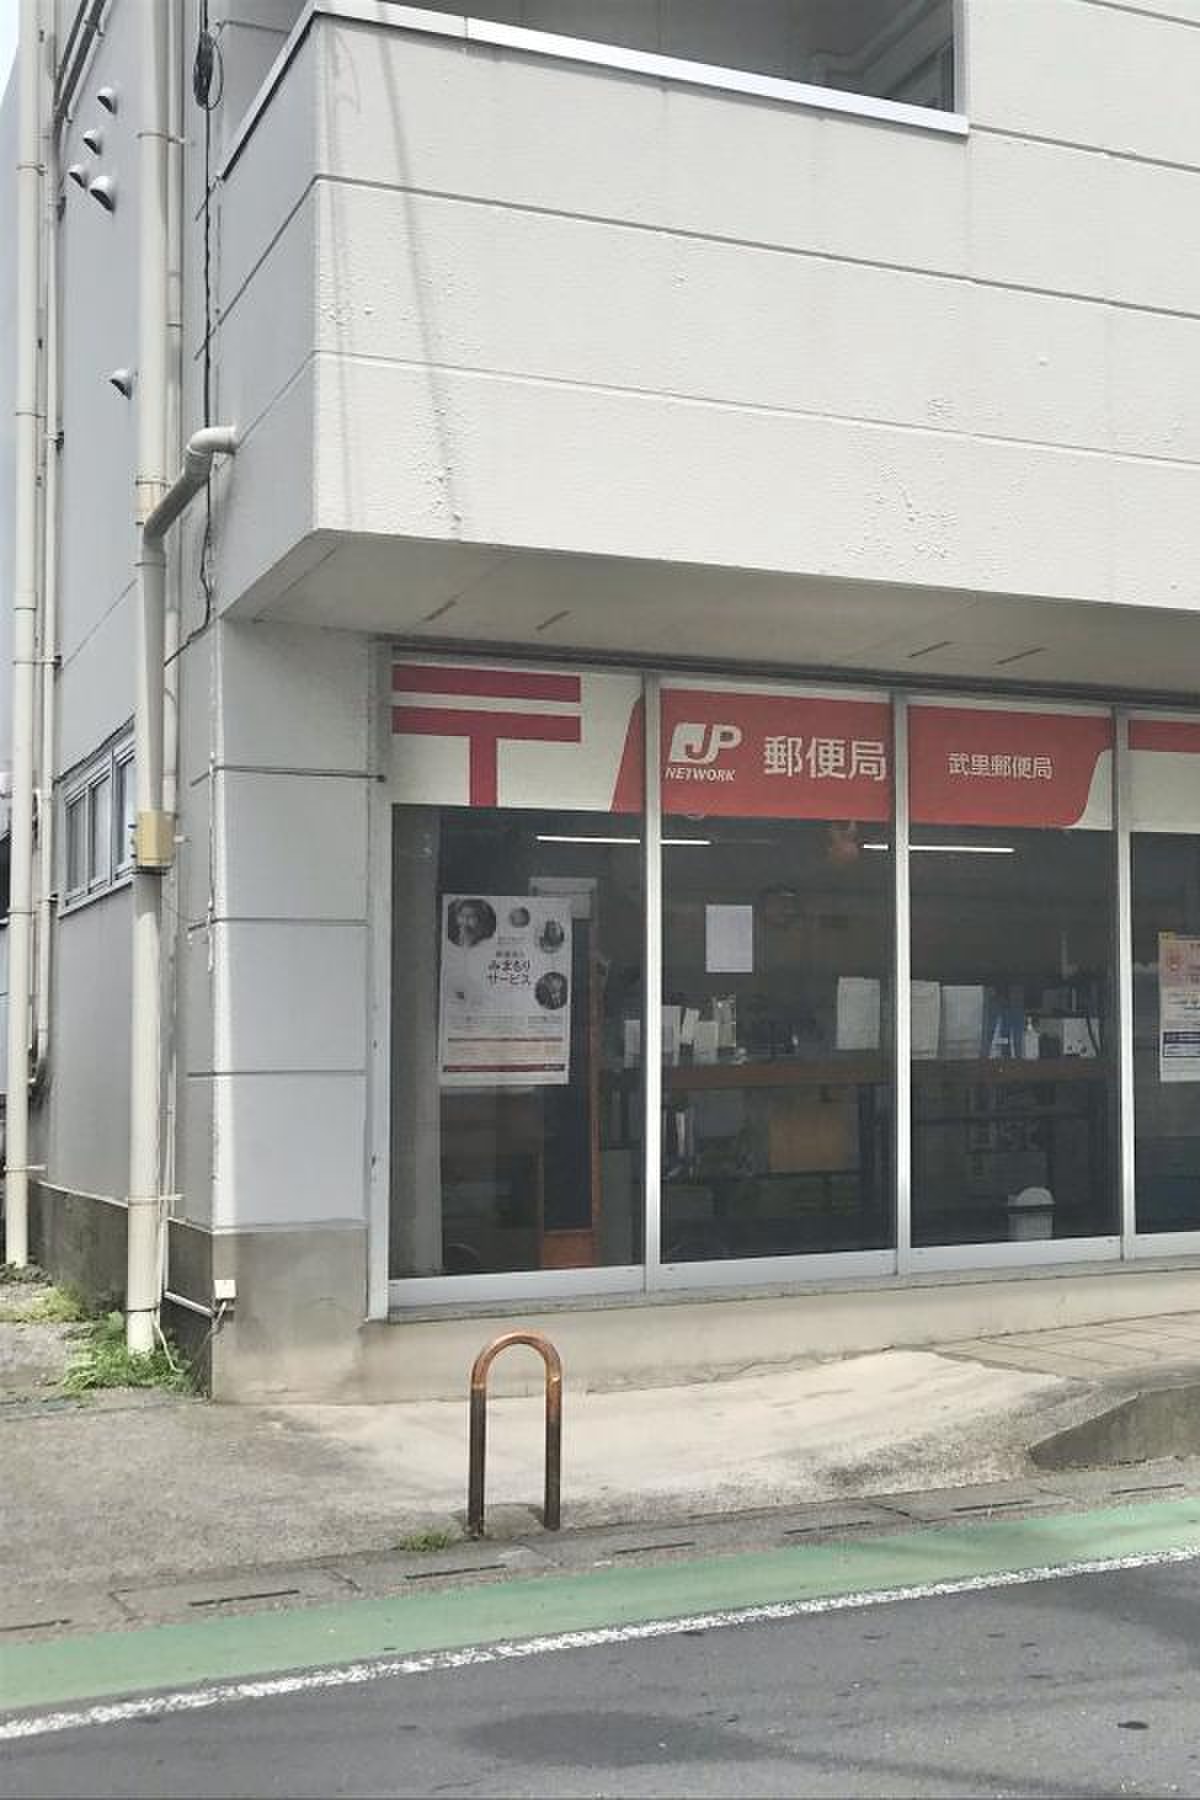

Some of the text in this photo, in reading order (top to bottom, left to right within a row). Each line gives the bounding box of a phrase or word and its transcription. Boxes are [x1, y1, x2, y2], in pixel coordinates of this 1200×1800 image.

[669, 722, 742, 764] JP
[763, 735, 887, 781] 郵便局
[948, 752, 1053, 780] 武里郵便局
[665, 767, 736, 781] NETWORK
[487, 974, 531, 986] サービス
